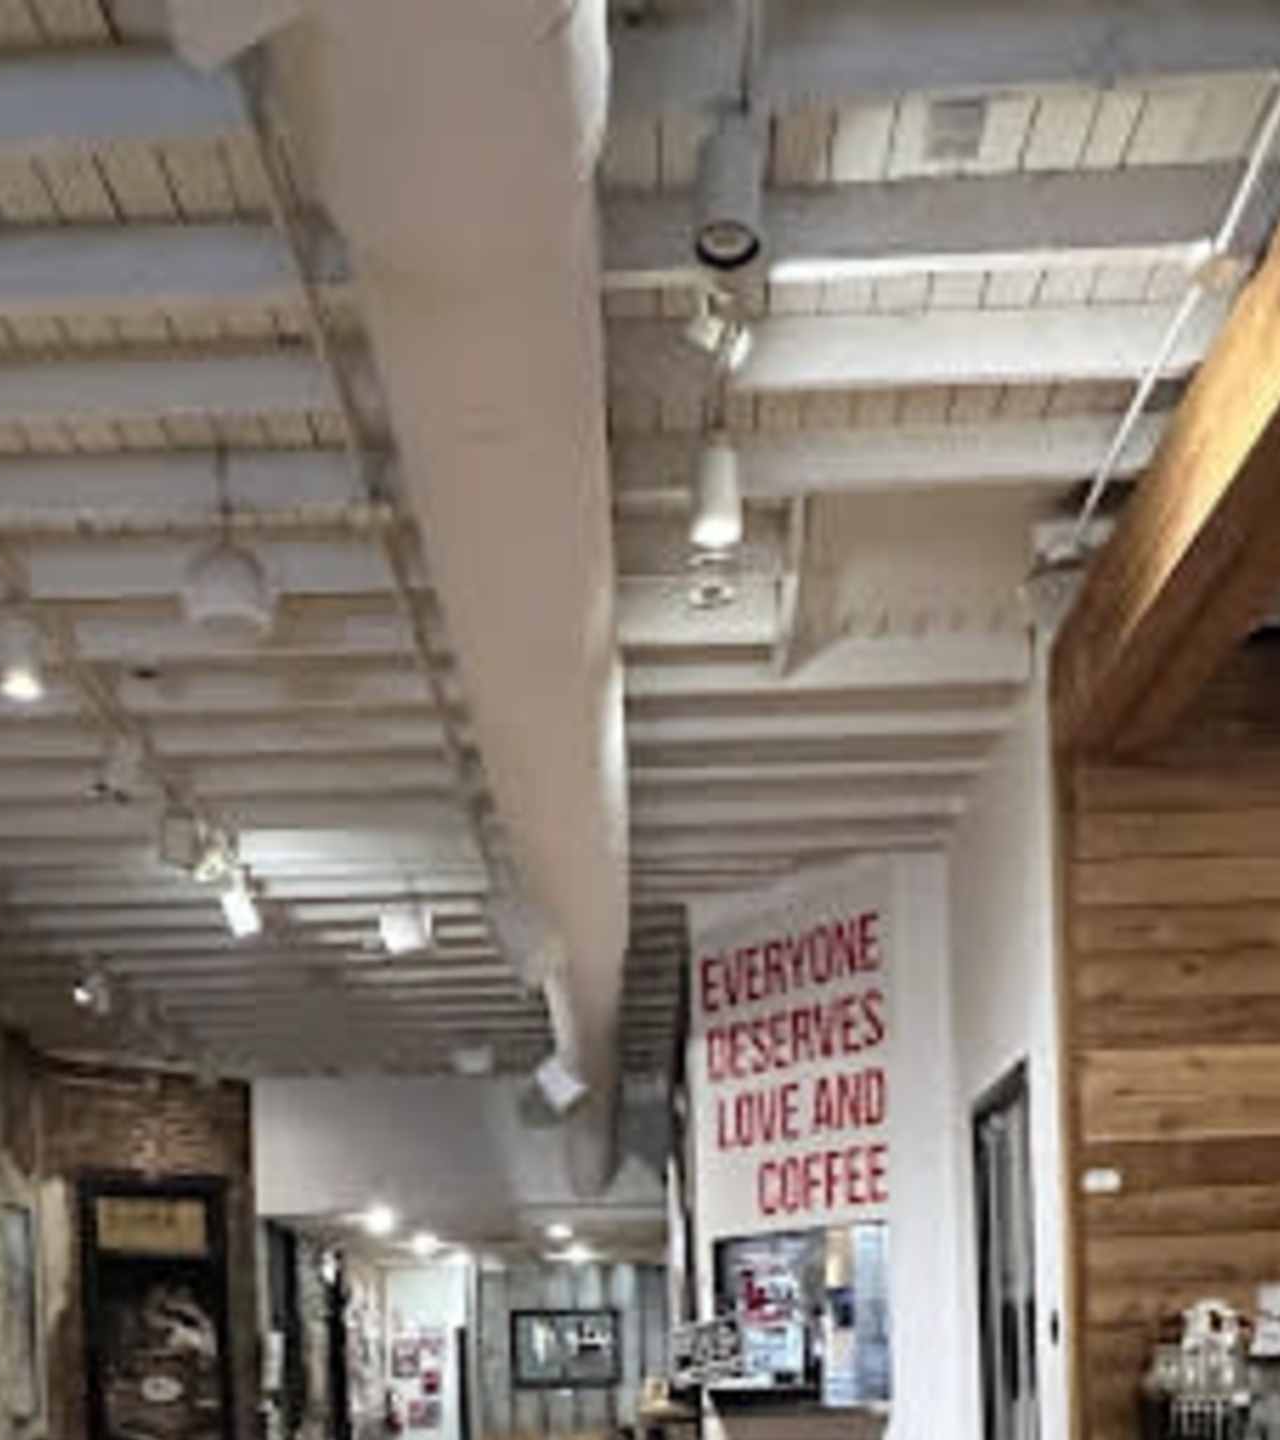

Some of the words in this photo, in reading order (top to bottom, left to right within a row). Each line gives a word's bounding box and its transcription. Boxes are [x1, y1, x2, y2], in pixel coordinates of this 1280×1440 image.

[700, 913, 879, 1012] EVERYONE
[706, 991, 884, 1081] DESERVES
[718, 1084, 800, 1149] LOVE
[813, 1069, 886, 1131] AND
[758, 1145, 889, 1215] COFFEE
